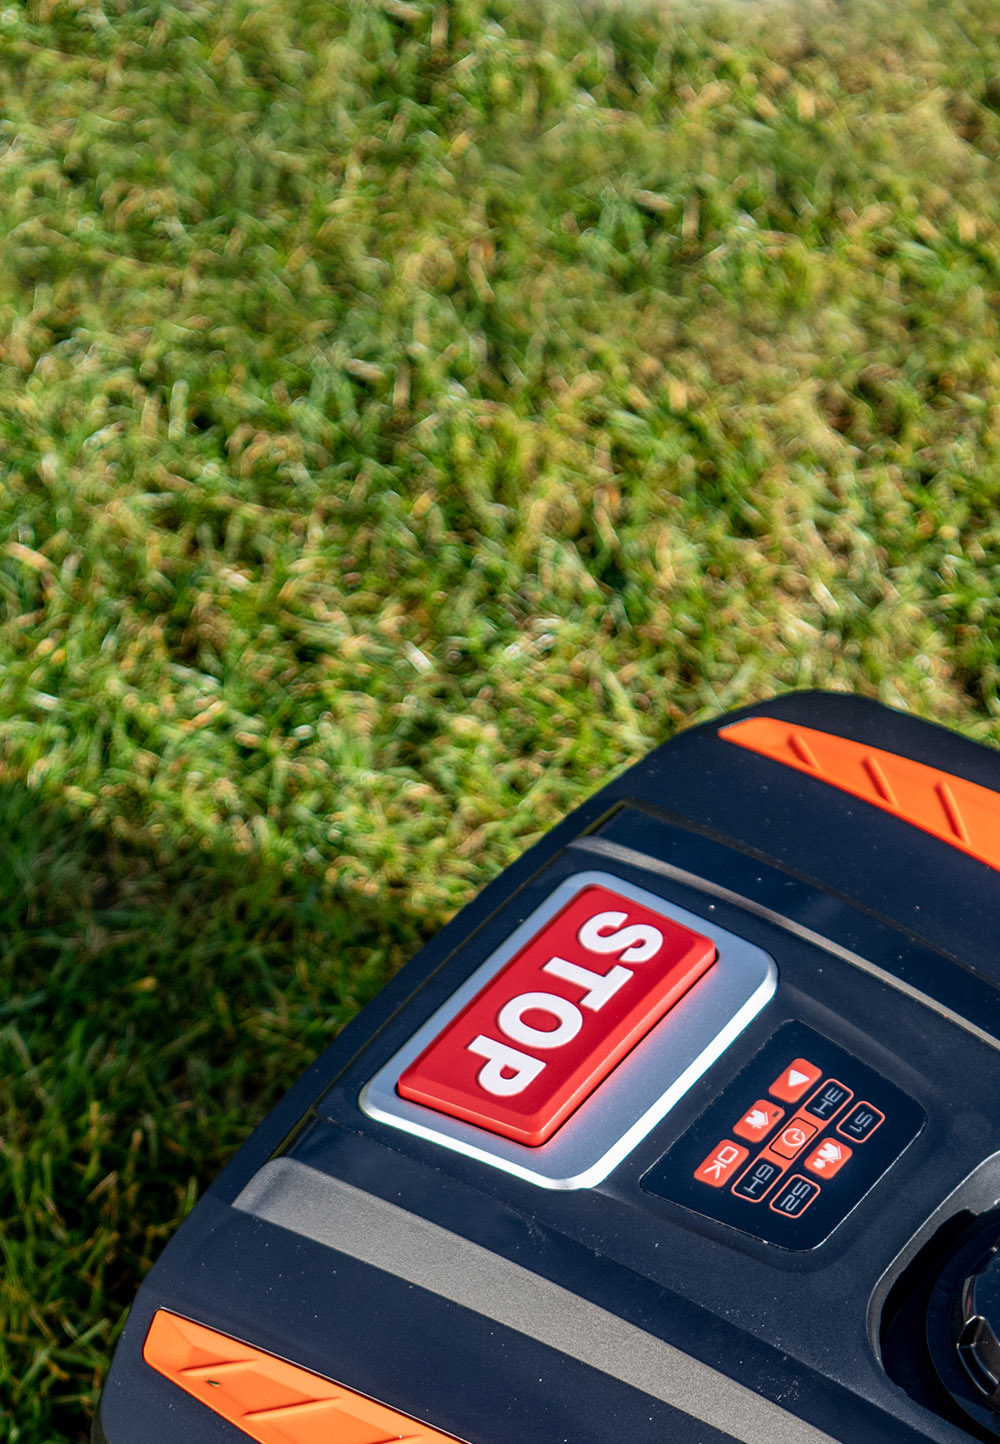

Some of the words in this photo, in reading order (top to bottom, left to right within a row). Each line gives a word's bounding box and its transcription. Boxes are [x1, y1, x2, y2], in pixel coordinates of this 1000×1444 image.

[465, 911, 665, 1097] STOP
[813, 1086, 844, 1116] 3H
[849, 1111, 874, 1133] S1
[703, 1145, 739, 1180] OK
[743, 1163, 775, 1195] 6H
[779, 1180, 812, 1212] S2
